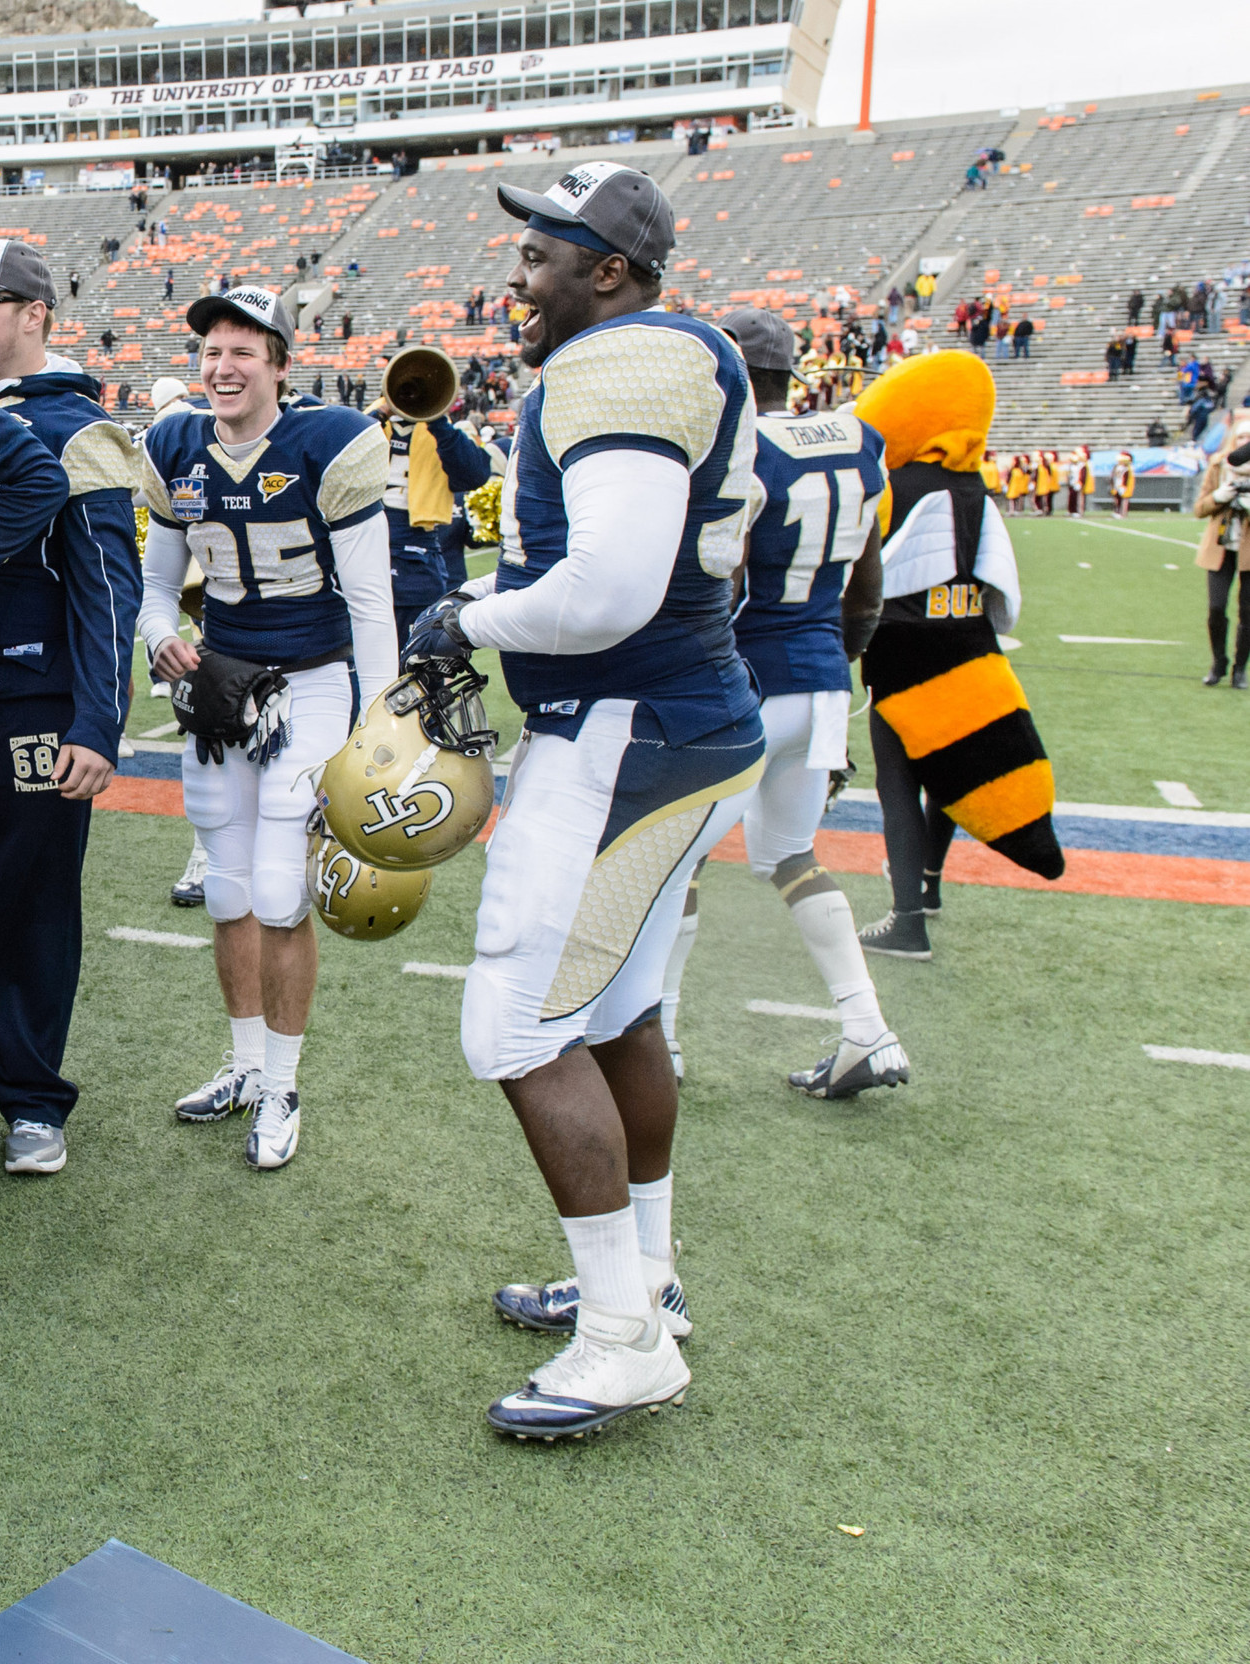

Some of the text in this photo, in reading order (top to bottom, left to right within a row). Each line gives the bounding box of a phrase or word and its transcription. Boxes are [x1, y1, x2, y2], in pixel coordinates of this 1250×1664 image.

[111, 59, 495, 105] THE UNIVERSITY OF TEXAS AT EL PASO
[785, 421, 848, 446] THOMAS
[264, 479, 284, 488] ACC
[221, 495, 251, 510] TECH
[10, 732, 59, 752] GEORGIA TECH
[12, 745, 54, 778] 68
